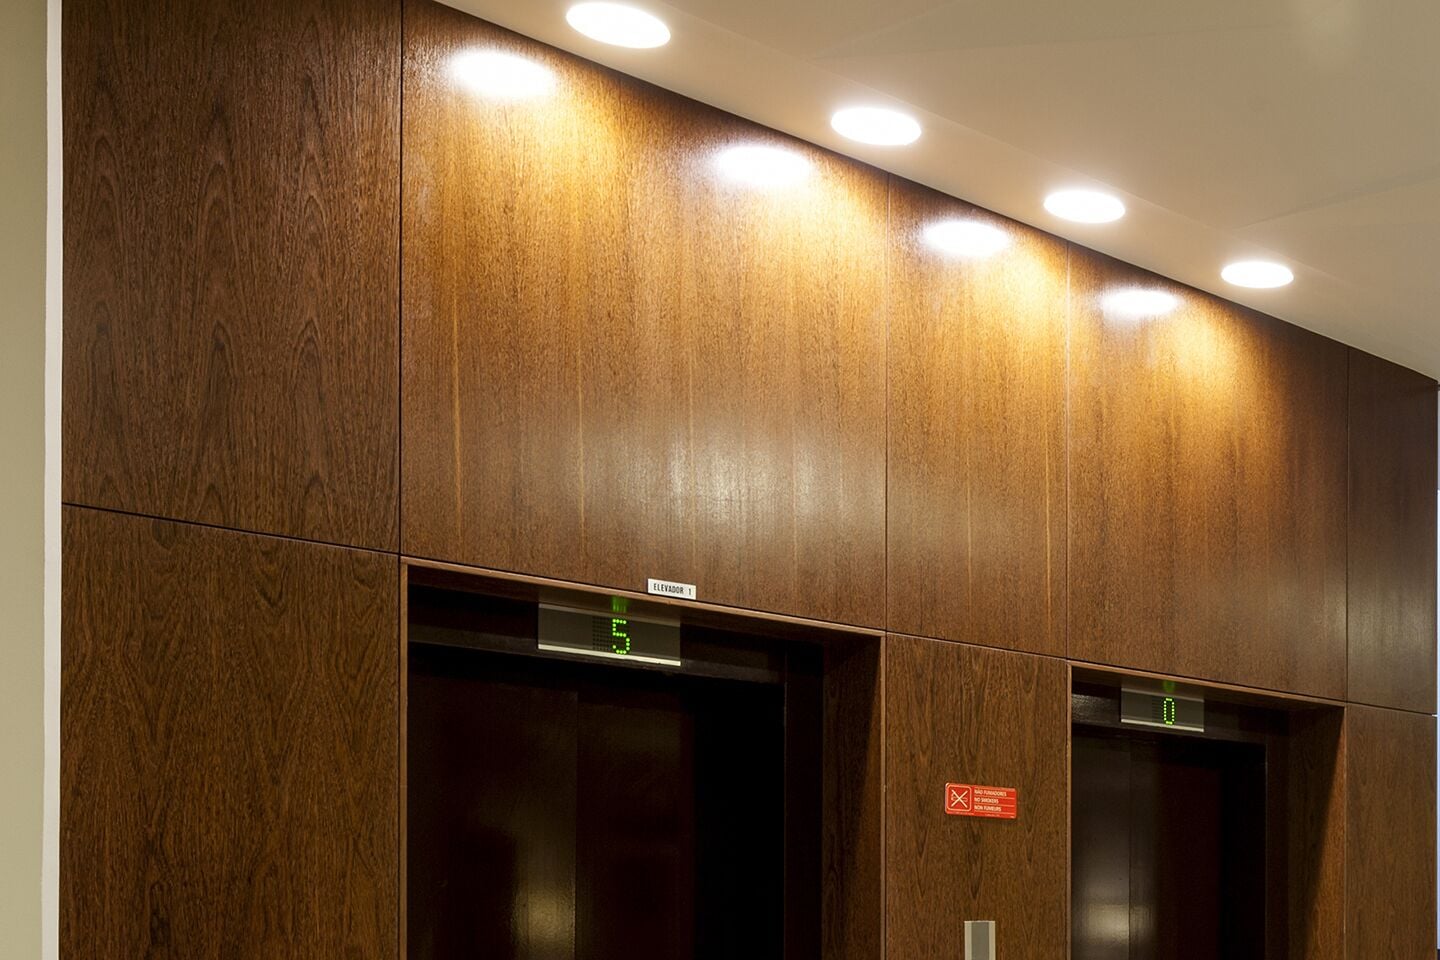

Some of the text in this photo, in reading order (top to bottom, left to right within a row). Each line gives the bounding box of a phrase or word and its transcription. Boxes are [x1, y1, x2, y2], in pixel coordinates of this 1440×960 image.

[653, 582, 692, 596] ELEVADOR 1
[612, 618, 631, 655] 5
[1163, 697, 1175, 725] 0
